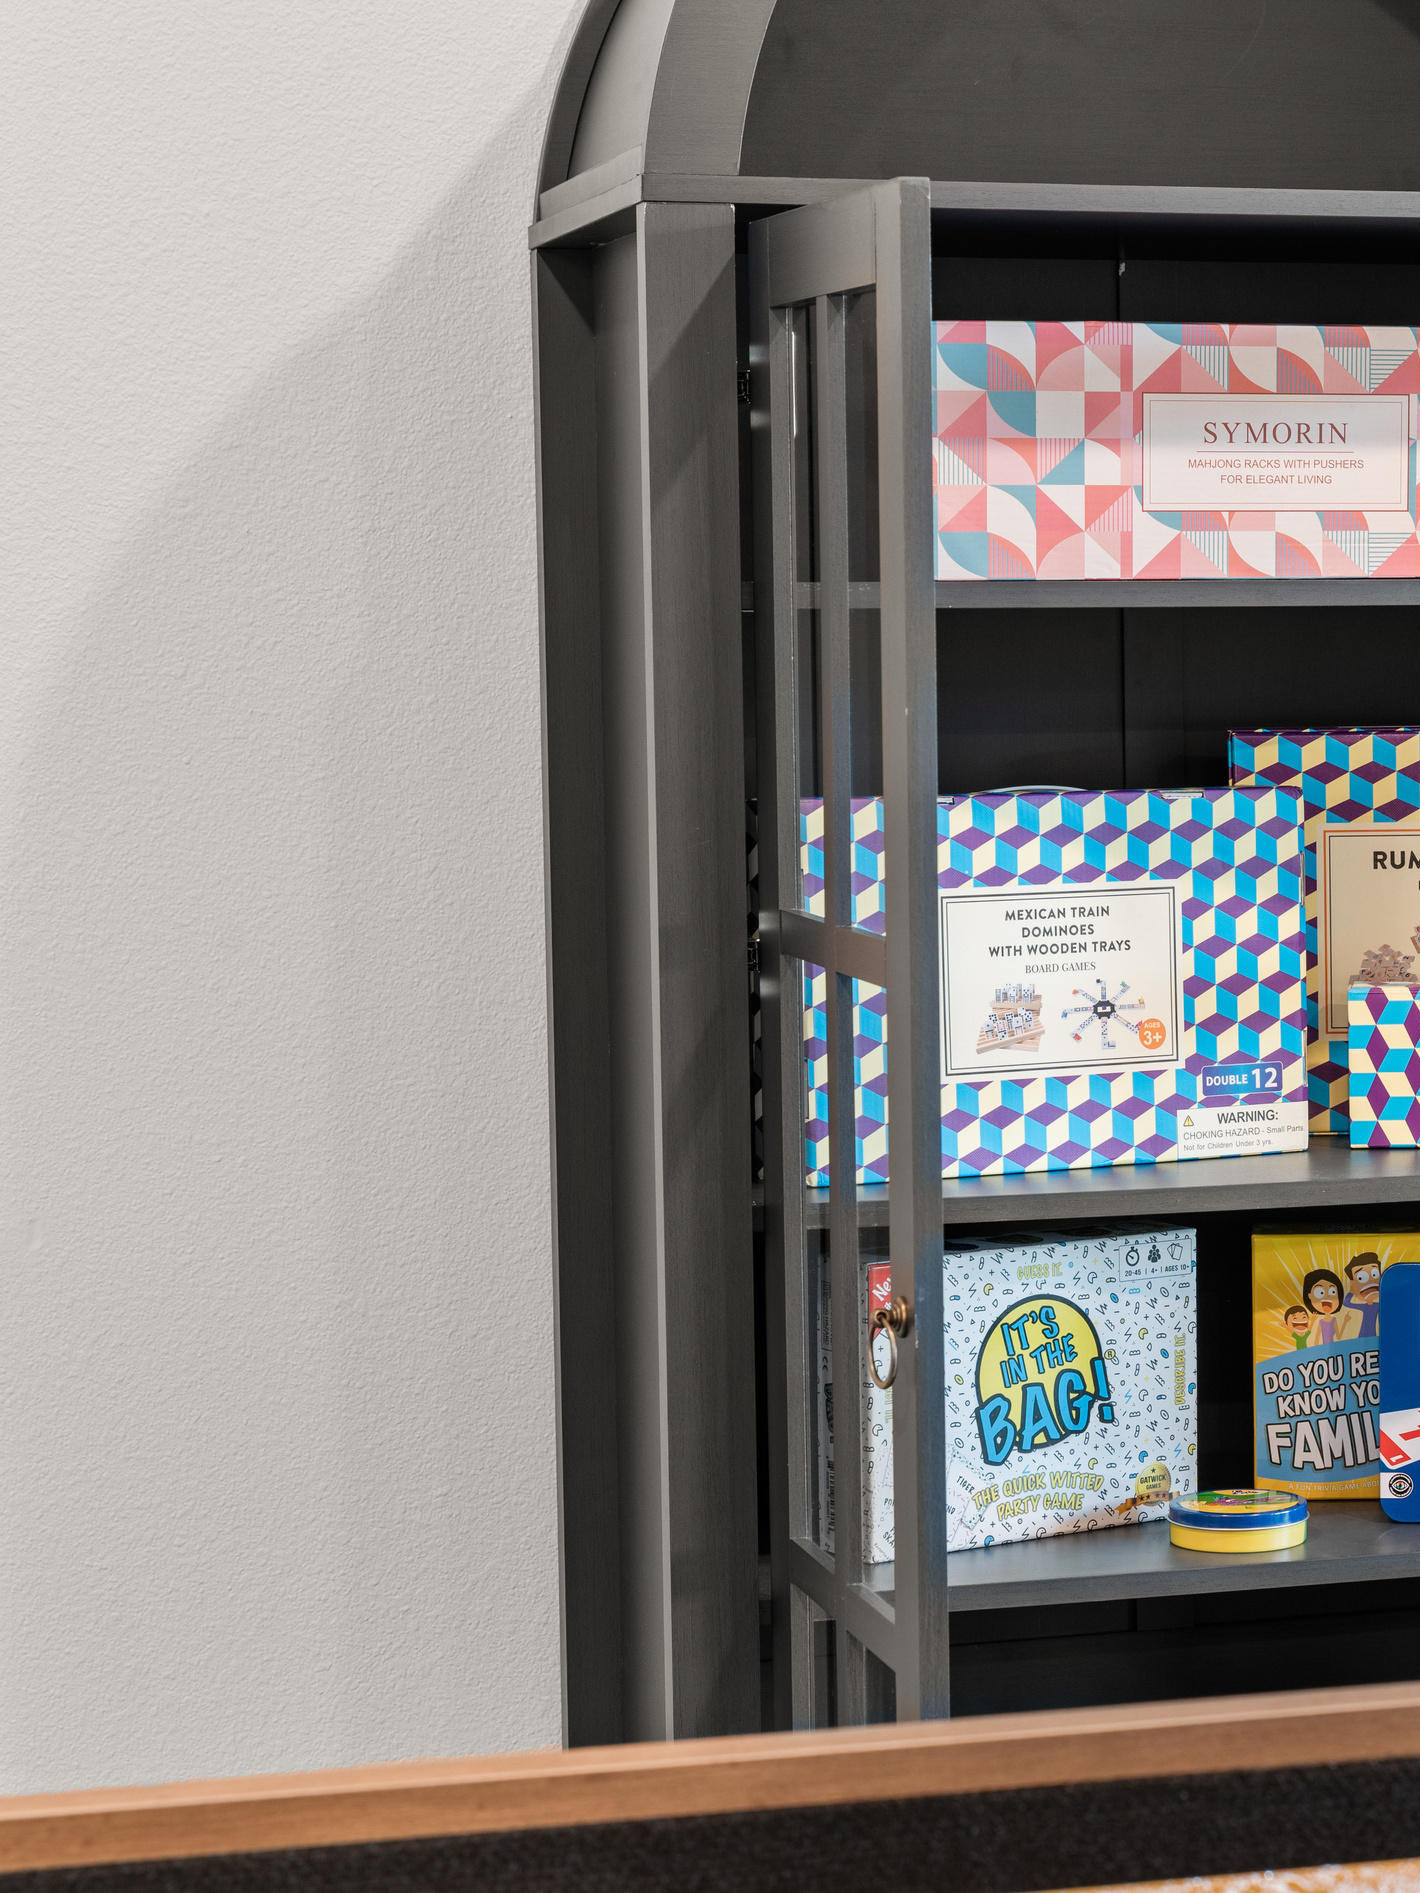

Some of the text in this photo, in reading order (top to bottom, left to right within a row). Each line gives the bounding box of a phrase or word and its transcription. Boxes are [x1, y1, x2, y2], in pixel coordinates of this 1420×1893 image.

[1203, 421, 1349, 445] SYMORIN
[1188, 459, 1364, 469] MAHJONG RACKS WITH PUSHERS
[1220, 475, 1332, 485] FOR ELEGANT LIVING
[1005, 905, 1110, 921] MEXICAN TRAIN
[1022, 924, 1094, 938] DOMINOES
[988, 940, 1131, 958] WITH WOODEN TRAYS
[1025, 962, 1096, 974] BOARD GAMES
[1144, 1021, 1161, 1029] AGES
[1143, 1030, 1162, 1045] 3+
[1206, 1067, 1278, 1089] DOUBLE 12
[1217, 1109, 1279, 1125] WARNING:
[1183, 1124, 1305, 1140] CHOKING HAZARD Small Parts.
[1207, 1141, 1233, 1149] Children
[1235, 1139, 1254, 1148] Under
[1262, 1140, 1273, 1148] yrs.
[1017, 1262, 1062, 1280] GUESS IT.
[872, 1277, 891, 1301] Ne
[1001, 1305, 1060, 1355] IT'S
[1000, 1332, 1078, 1388] IN THE
[1174, 1333, 1186, 1405] DESCRIBE IT.
[1263, 1367, 1294, 1395] DO
[1298, 1354, 1344, 1388] YOU
[1277, 1380, 1380, 1419] KNOW YO
[976, 1356, 1115, 1465] BAG!
[1266, 1411, 1380, 1470] FAMIL
[957, 1476, 975, 1495] TIGER
[1140, 1474, 1166, 1484] GATWICK
[1296, 1483, 1310, 1491] FUN
[1314, 1484, 1337, 1492] TRIVIA
[1338, 1483, 1360, 1491] GAME
[972, 1484, 1000, 1510] THE
[1002, 1472, 1046, 1497] QUICK
[1050, 1470, 1104, 1492] WITTED
[996, 1492, 1084, 1521] PARTY GAME
